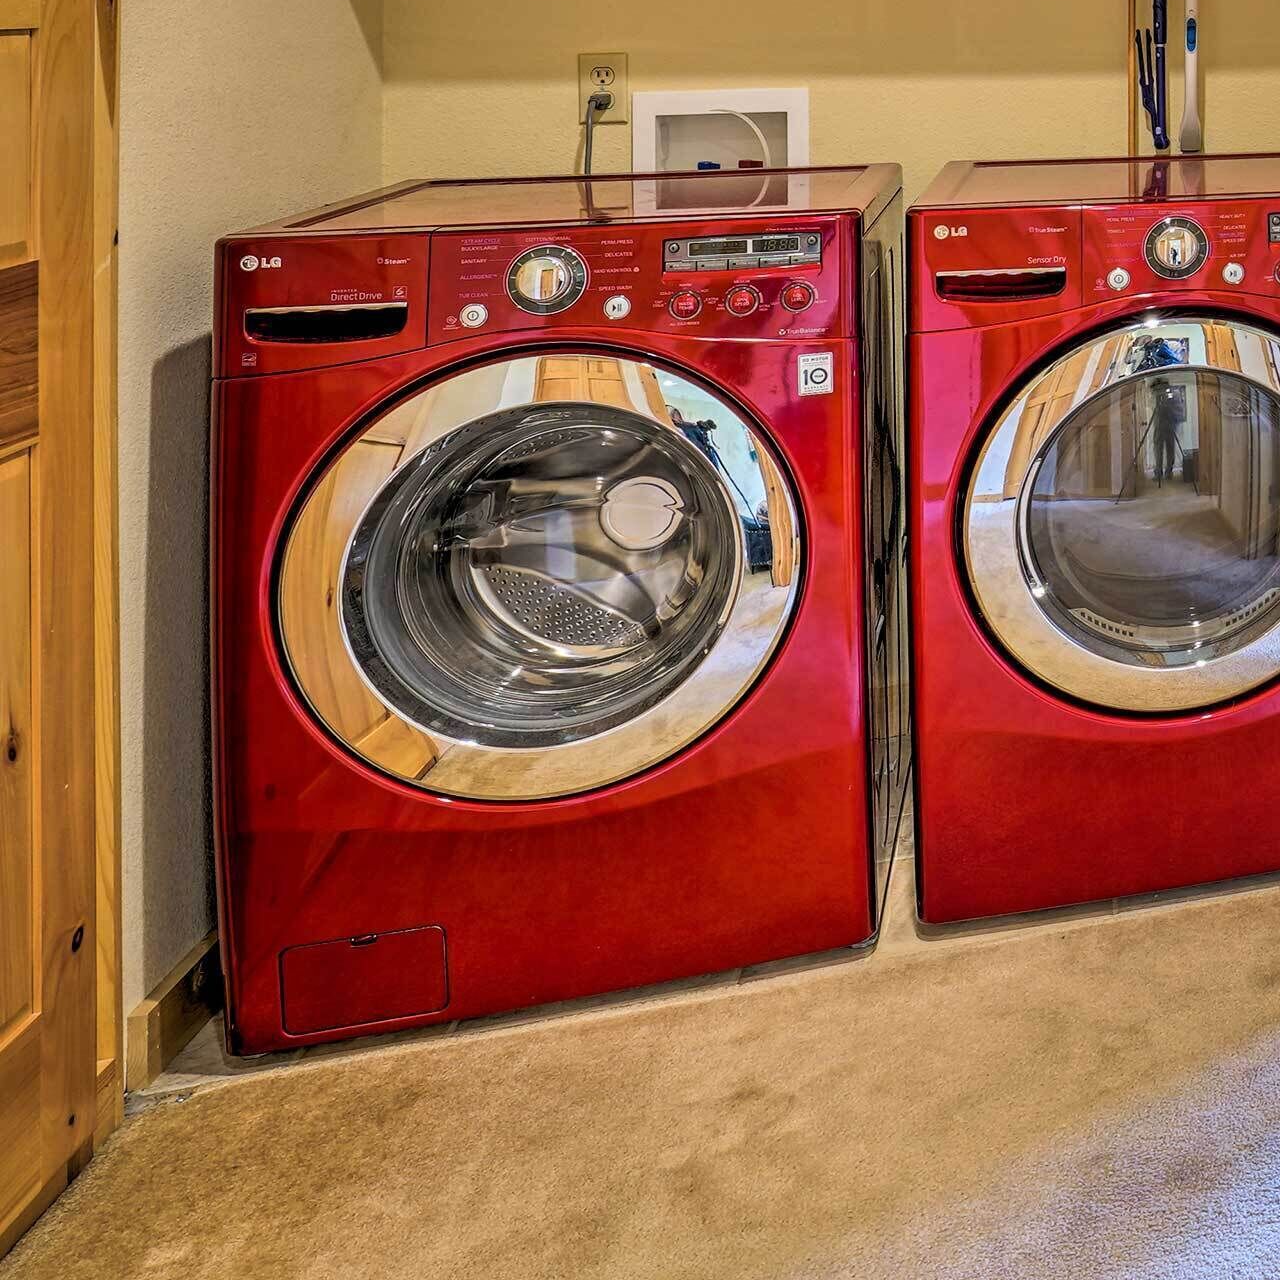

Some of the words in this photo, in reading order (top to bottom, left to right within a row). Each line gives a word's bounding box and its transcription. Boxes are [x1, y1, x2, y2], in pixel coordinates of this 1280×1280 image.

[951, 227, 968, 237] LG
[261, 257, 281, 268] LG
[1027, 256, 1051, 265] Sensor
[1053, 255, 1067, 265] Dry
[330, 293, 358, 302] Direct
[359, 292, 383, 300] Drive
